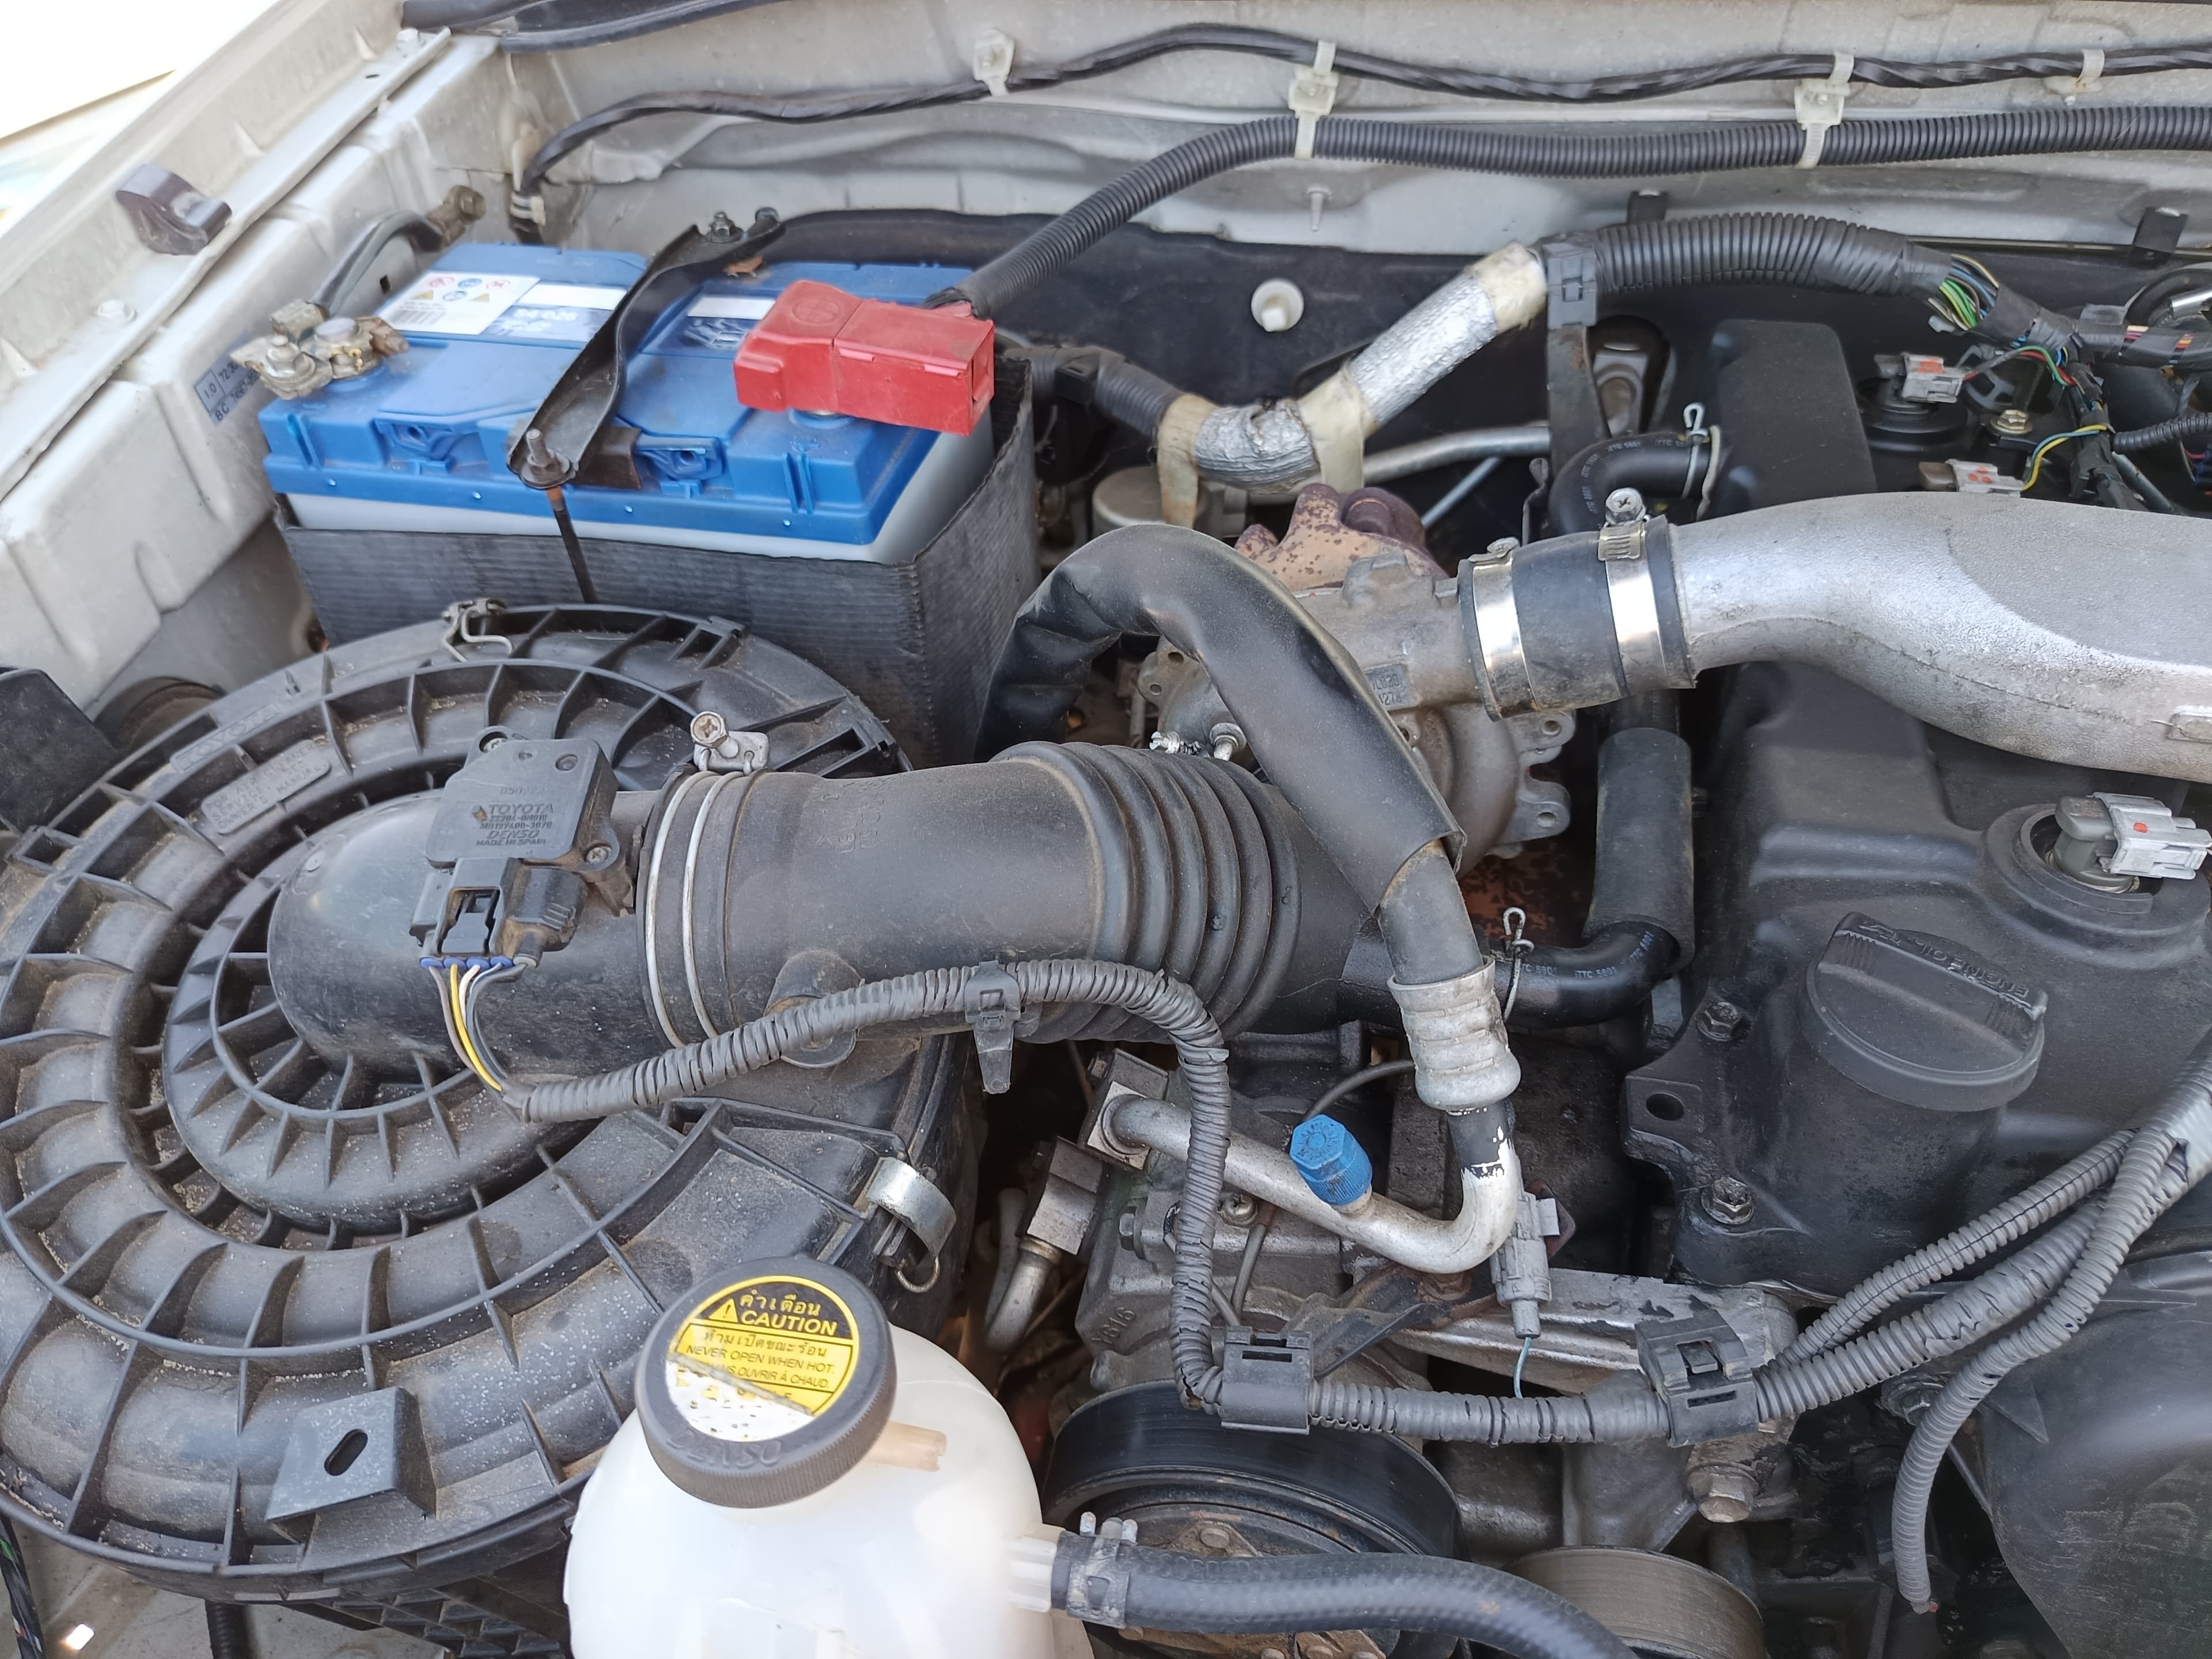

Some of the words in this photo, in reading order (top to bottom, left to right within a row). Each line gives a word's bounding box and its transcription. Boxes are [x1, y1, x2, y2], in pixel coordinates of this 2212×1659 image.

[489, 803, 554, 814] TOYOTA
[486, 830, 540, 839] DENSO
[740, 1289, 821, 1317] คำเตือน
[741, 1310, 838, 1336] CAUTION
[686, 1345, 728, 1358] NEVER
[730, 1350, 764, 1363] OPEN
[768, 1355, 804, 1369] WHEN
[806, 1362, 835, 1374] HOT.
[738, 1367, 778, 1381] OUVRIR
